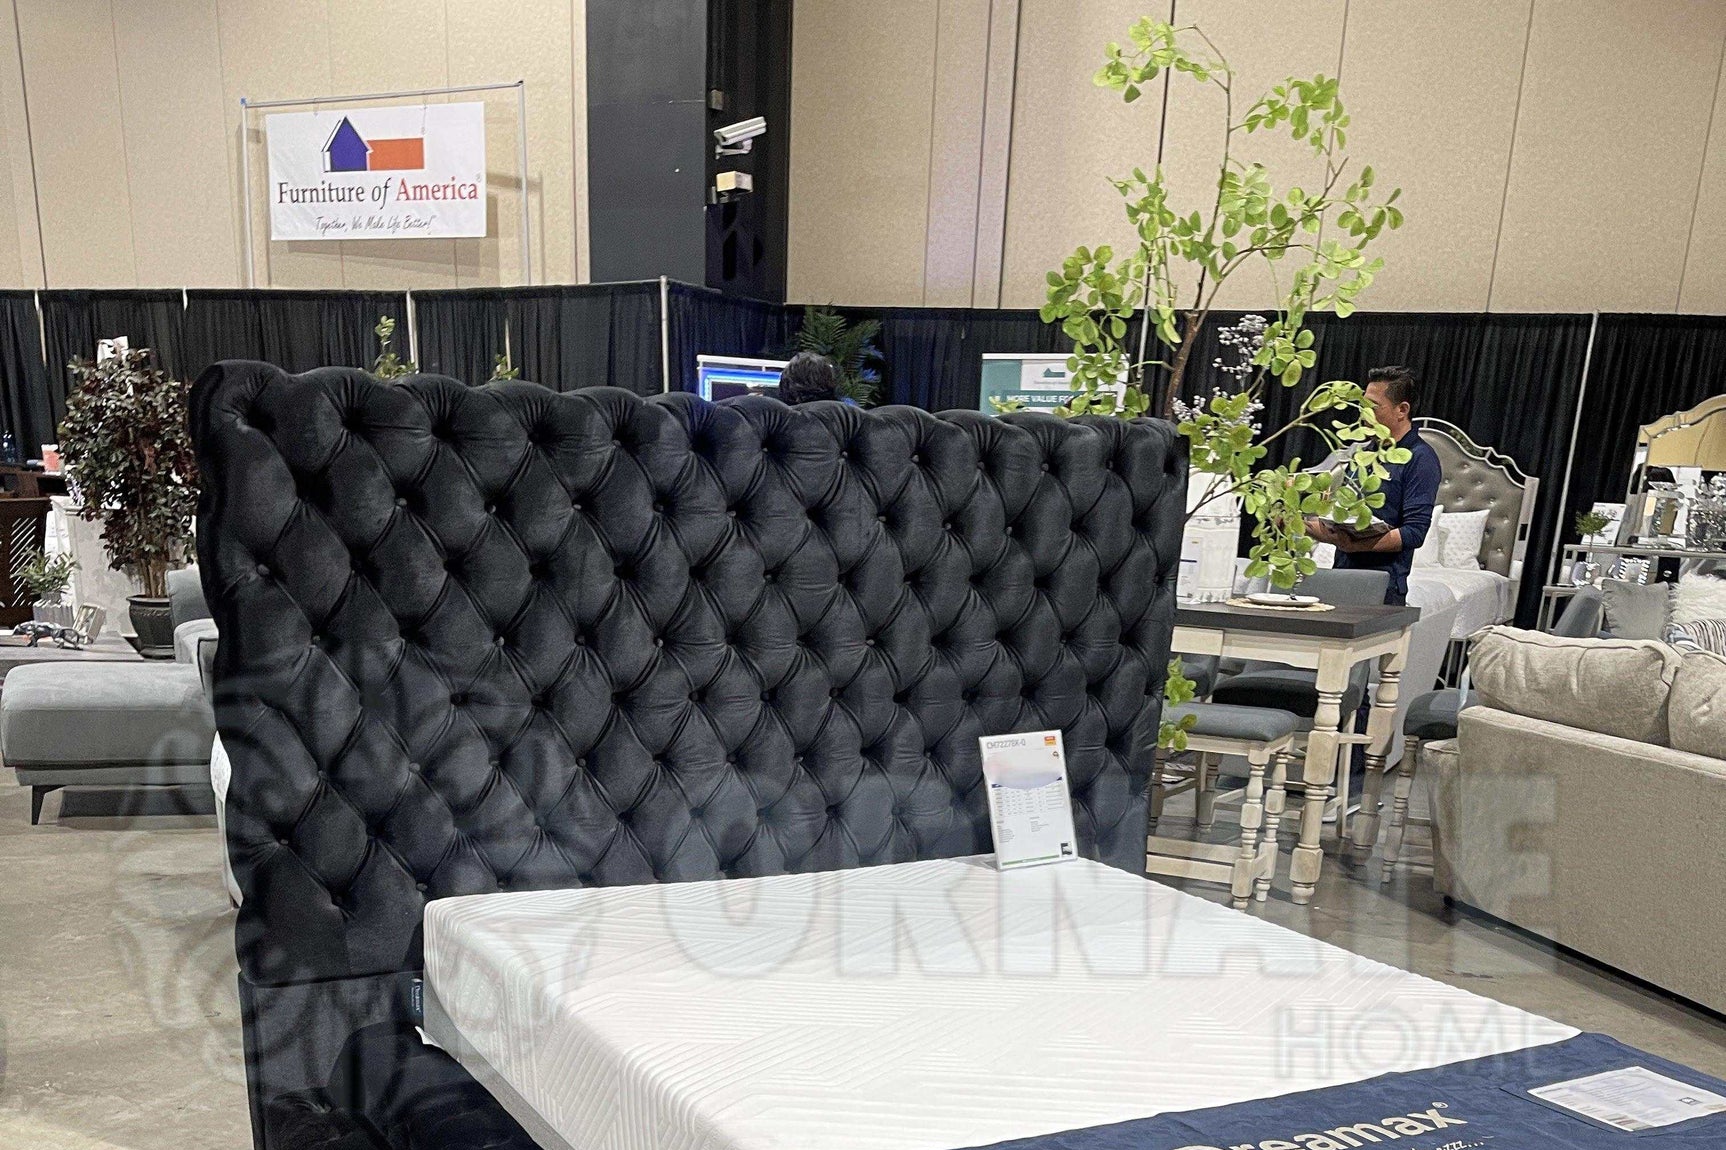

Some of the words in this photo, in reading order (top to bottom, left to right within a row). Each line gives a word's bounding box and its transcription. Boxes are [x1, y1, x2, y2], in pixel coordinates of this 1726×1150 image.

[278, 180, 365, 204] Furniture
[371, 177, 392, 209] of
[396, 176, 478, 201] America
[1031, 395, 1058, 403] VALUE
